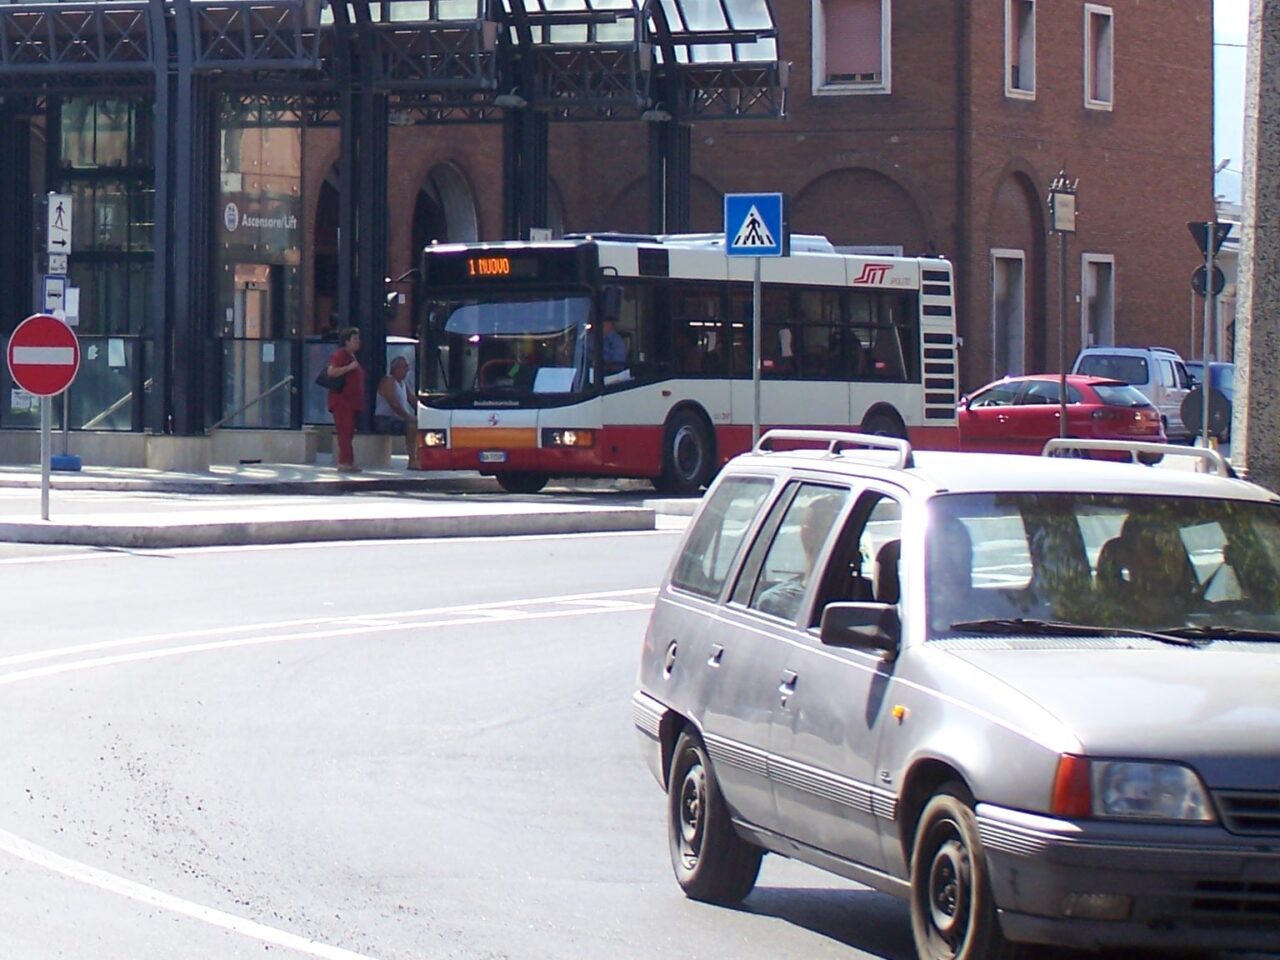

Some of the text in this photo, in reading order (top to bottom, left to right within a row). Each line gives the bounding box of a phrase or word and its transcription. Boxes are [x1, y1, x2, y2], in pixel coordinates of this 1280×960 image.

[241, 213, 297, 229] Ascensore/Lift
[469, 258, 510, 275] 1 NUOVO
